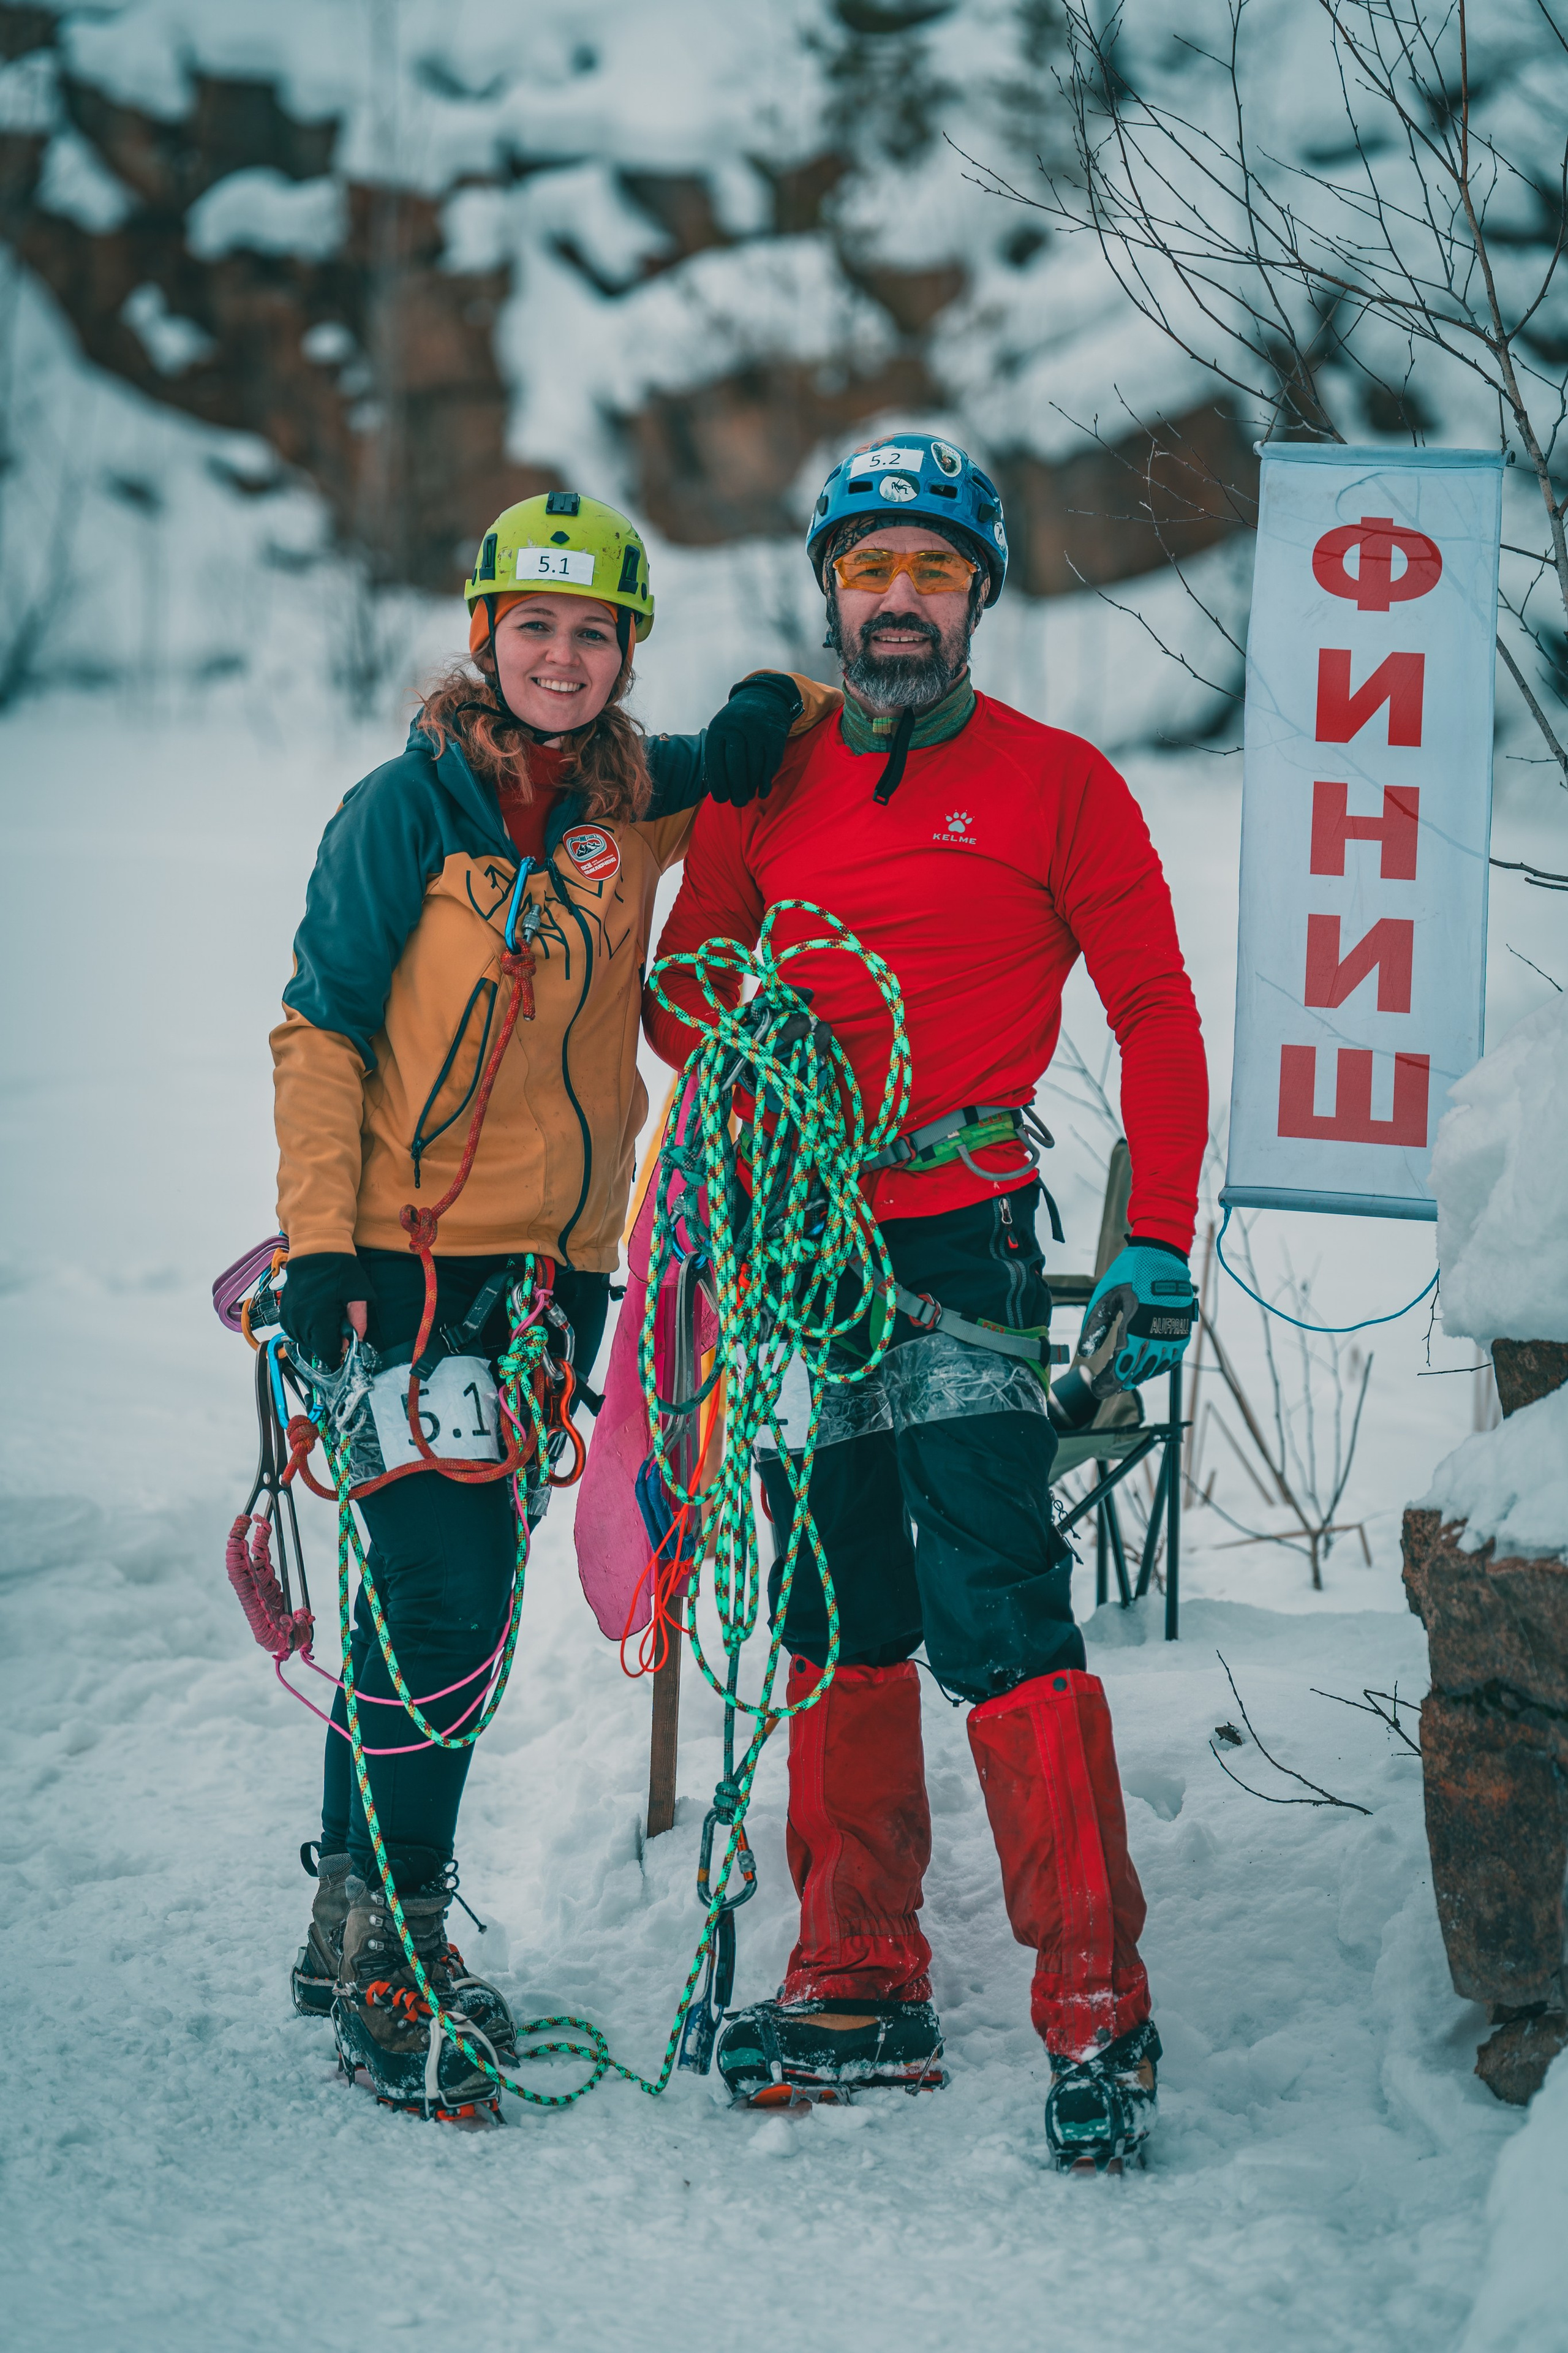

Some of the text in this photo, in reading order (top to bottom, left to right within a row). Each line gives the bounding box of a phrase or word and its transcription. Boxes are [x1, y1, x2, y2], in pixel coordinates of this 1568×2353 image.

[869, 453, 901, 467] 5.2
[538, 556, 570, 575] 5.1
[932, 833, 977, 845] KELME
[1278, 517, 1442, 1147] ФИНИШ
[1150, 1317, 1189, 1334] AUFPRALL
[401, 1381, 491, 1446] 5.1
